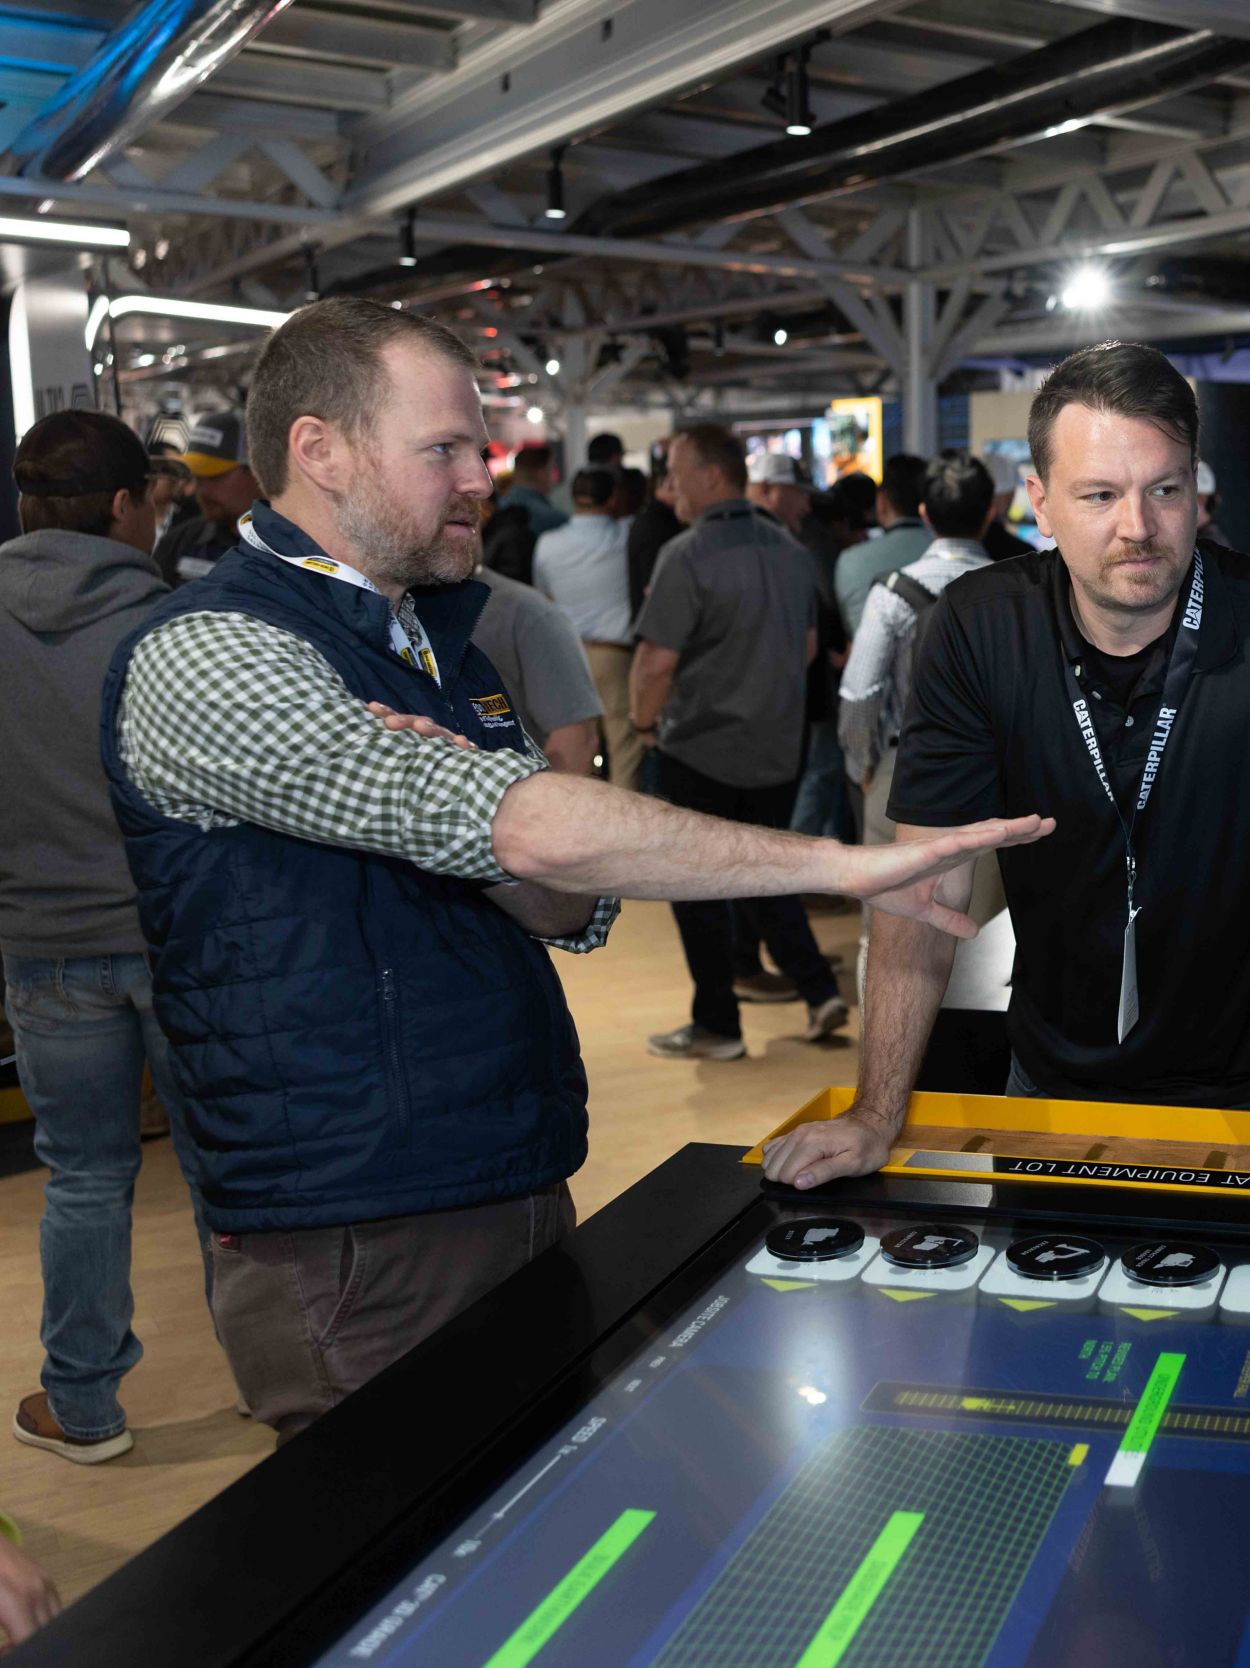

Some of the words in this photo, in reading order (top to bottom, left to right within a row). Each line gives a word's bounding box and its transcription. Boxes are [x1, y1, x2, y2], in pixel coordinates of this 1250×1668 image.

[1182, 547, 1204, 630] CATERPILL
[1136, 706, 1177, 810] CATERPILLAR
[1008, 1161, 1057, 1173] LOT
[1062, 1164, 1210, 1183] EQUIPMENT
[696, 1295, 731, 1321] JOBSITE
[668, 1319, 706, 1348] CAMERA
[571, 1416, 608, 1444] SPEED
